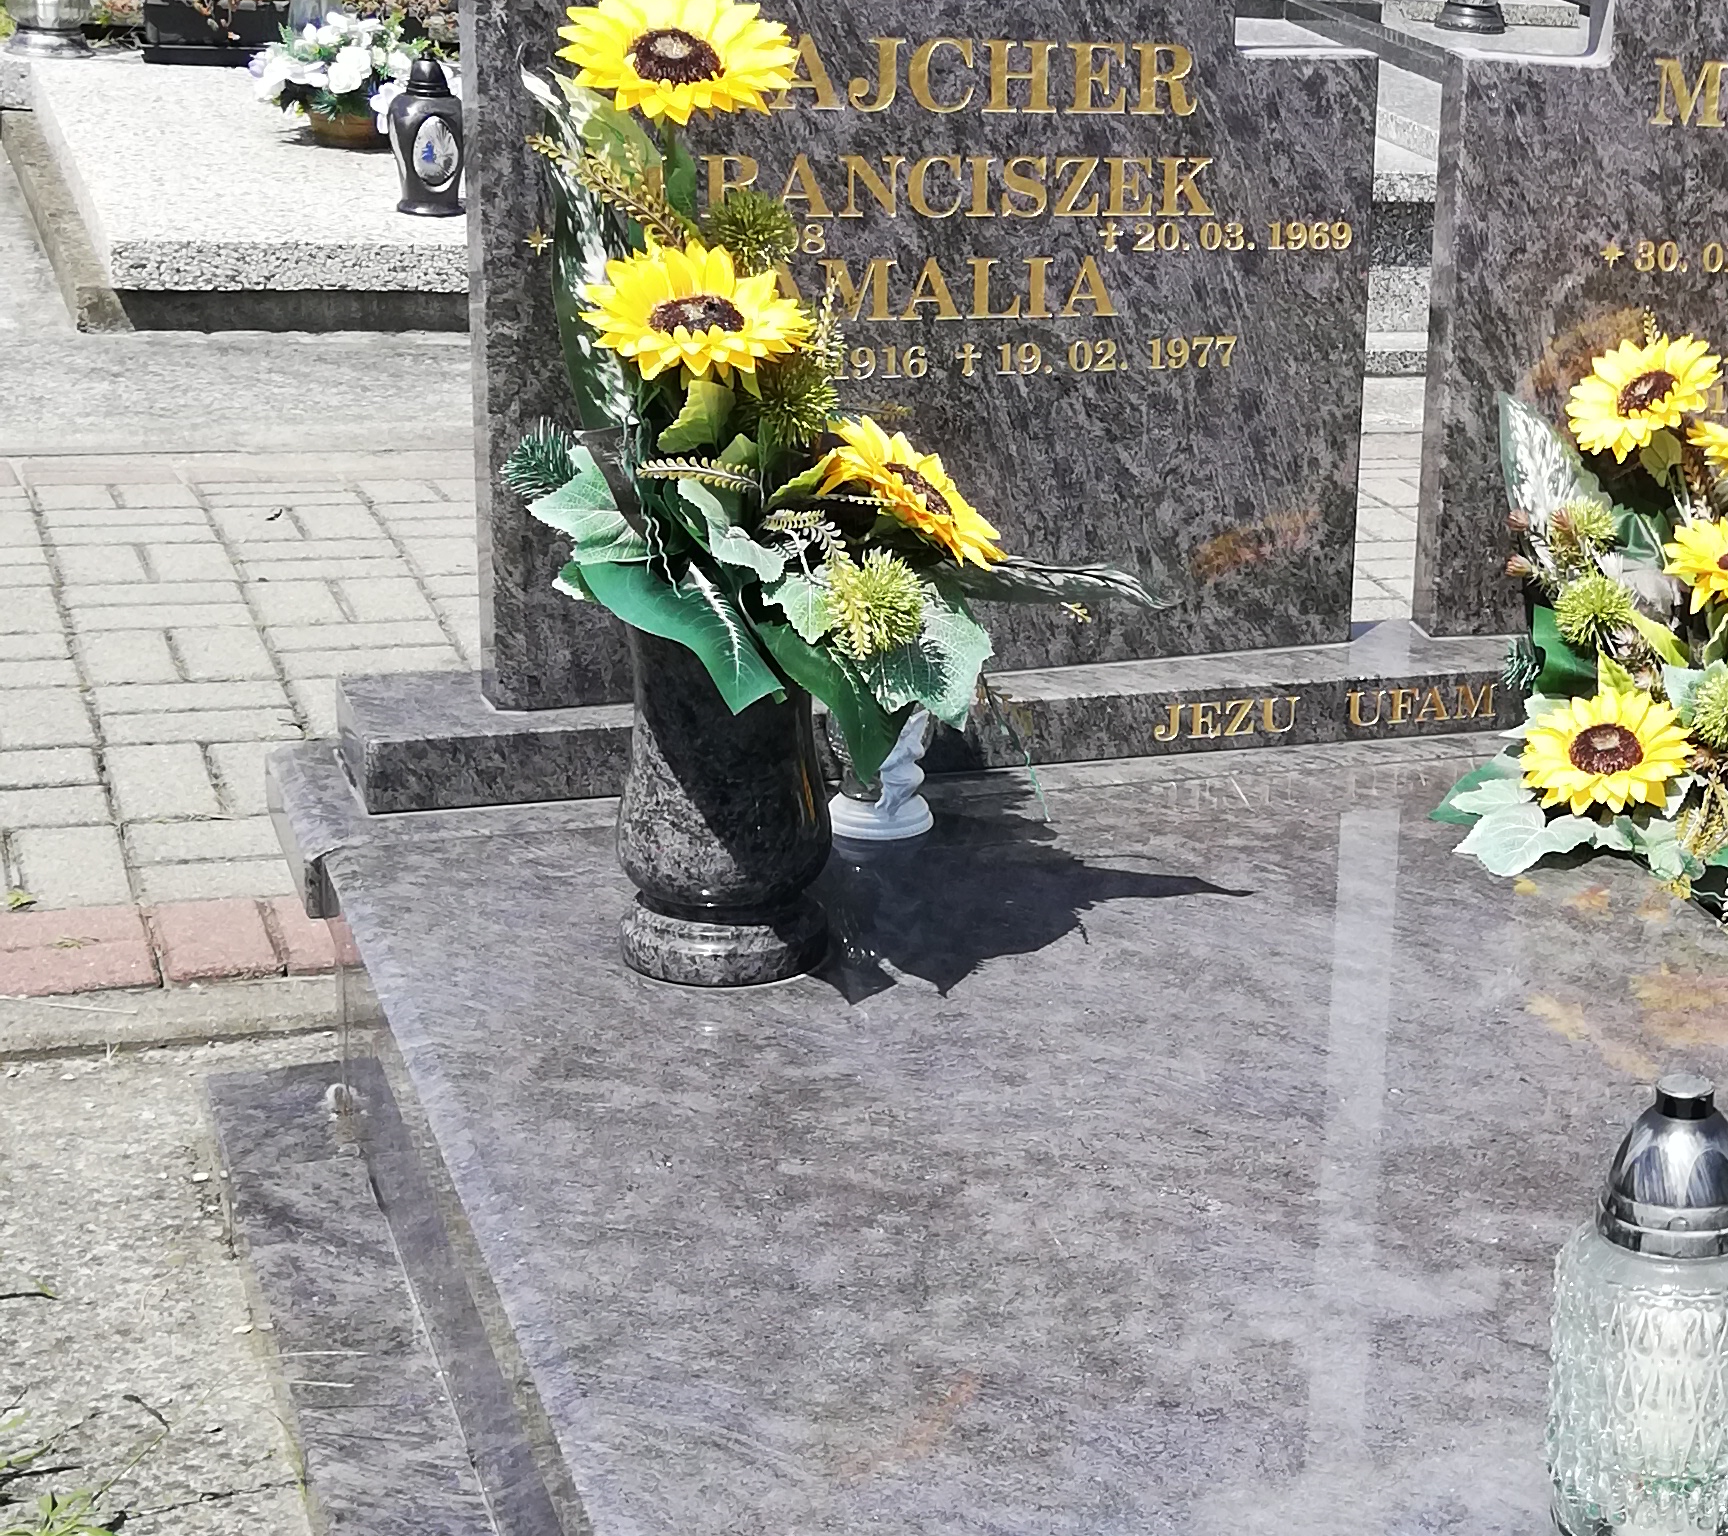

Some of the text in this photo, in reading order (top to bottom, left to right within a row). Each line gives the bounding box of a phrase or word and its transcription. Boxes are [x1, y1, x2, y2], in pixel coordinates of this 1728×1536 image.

[770, 33, 1198, 117] AJCHER
[645, 152, 1215, 220] RANCISZEK
[1267, 221, 1353, 252] 1969
[1148, 335, 1238, 370] 1977
[1153, 682, 1498, 743] JEZU UFAM
